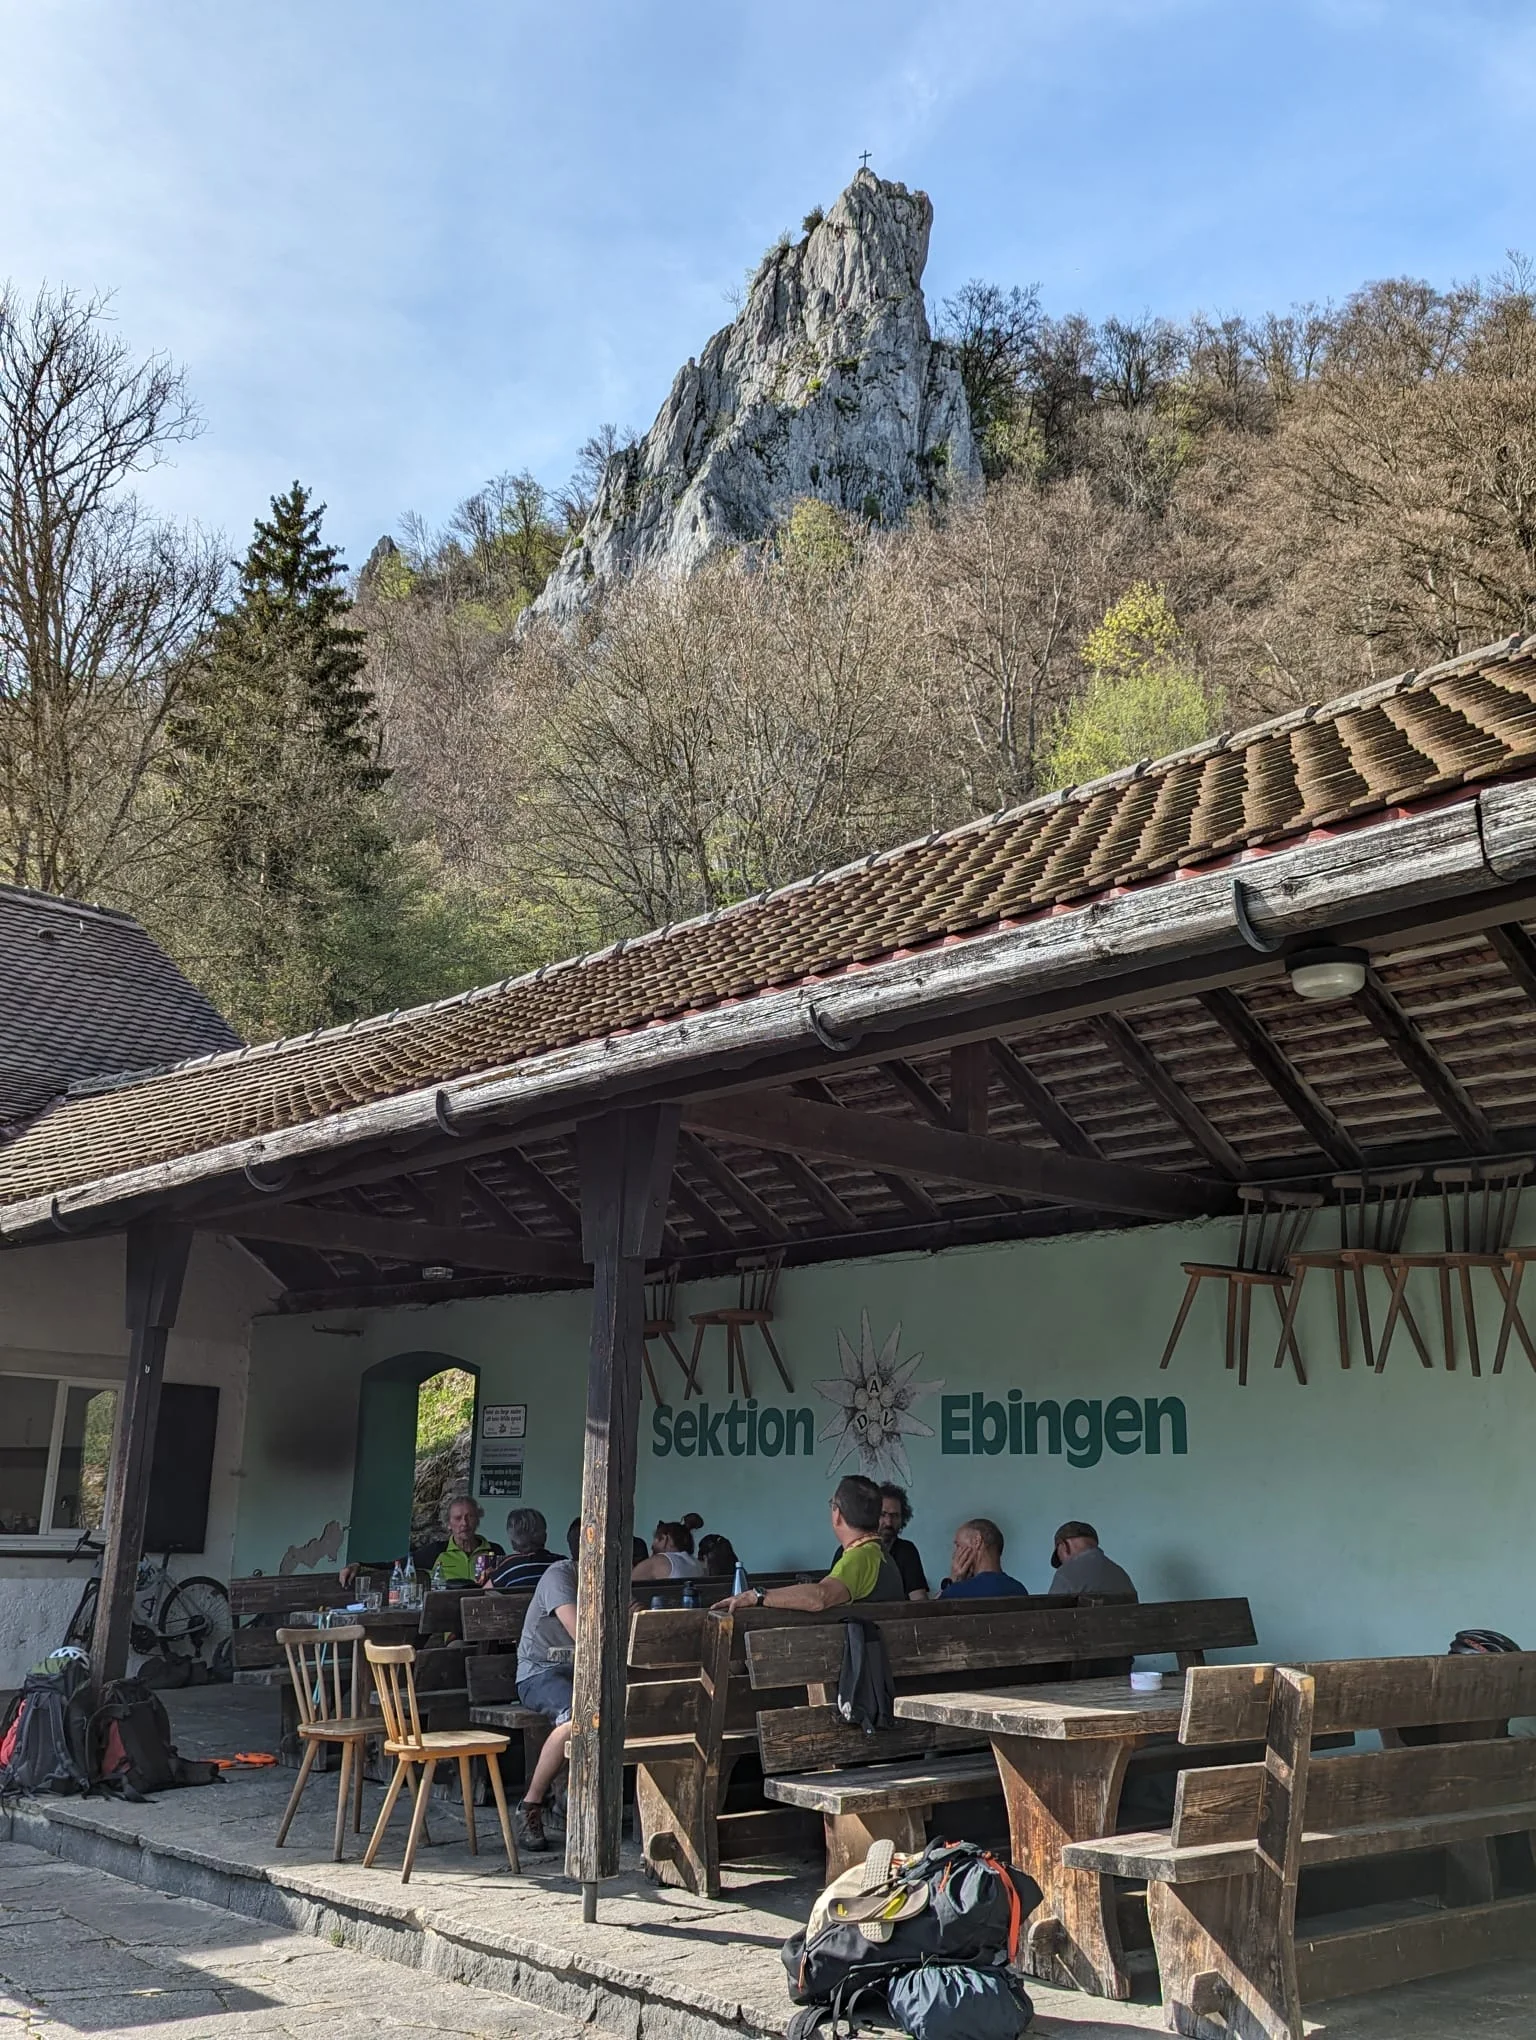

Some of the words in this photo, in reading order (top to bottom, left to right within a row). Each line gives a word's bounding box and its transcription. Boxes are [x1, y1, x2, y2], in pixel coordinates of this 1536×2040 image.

[869, 1379, 880, 1393] A
[652, 1399, 814, 1457] Sektion
[941, 1389, 1188, 1468] Ebingen
